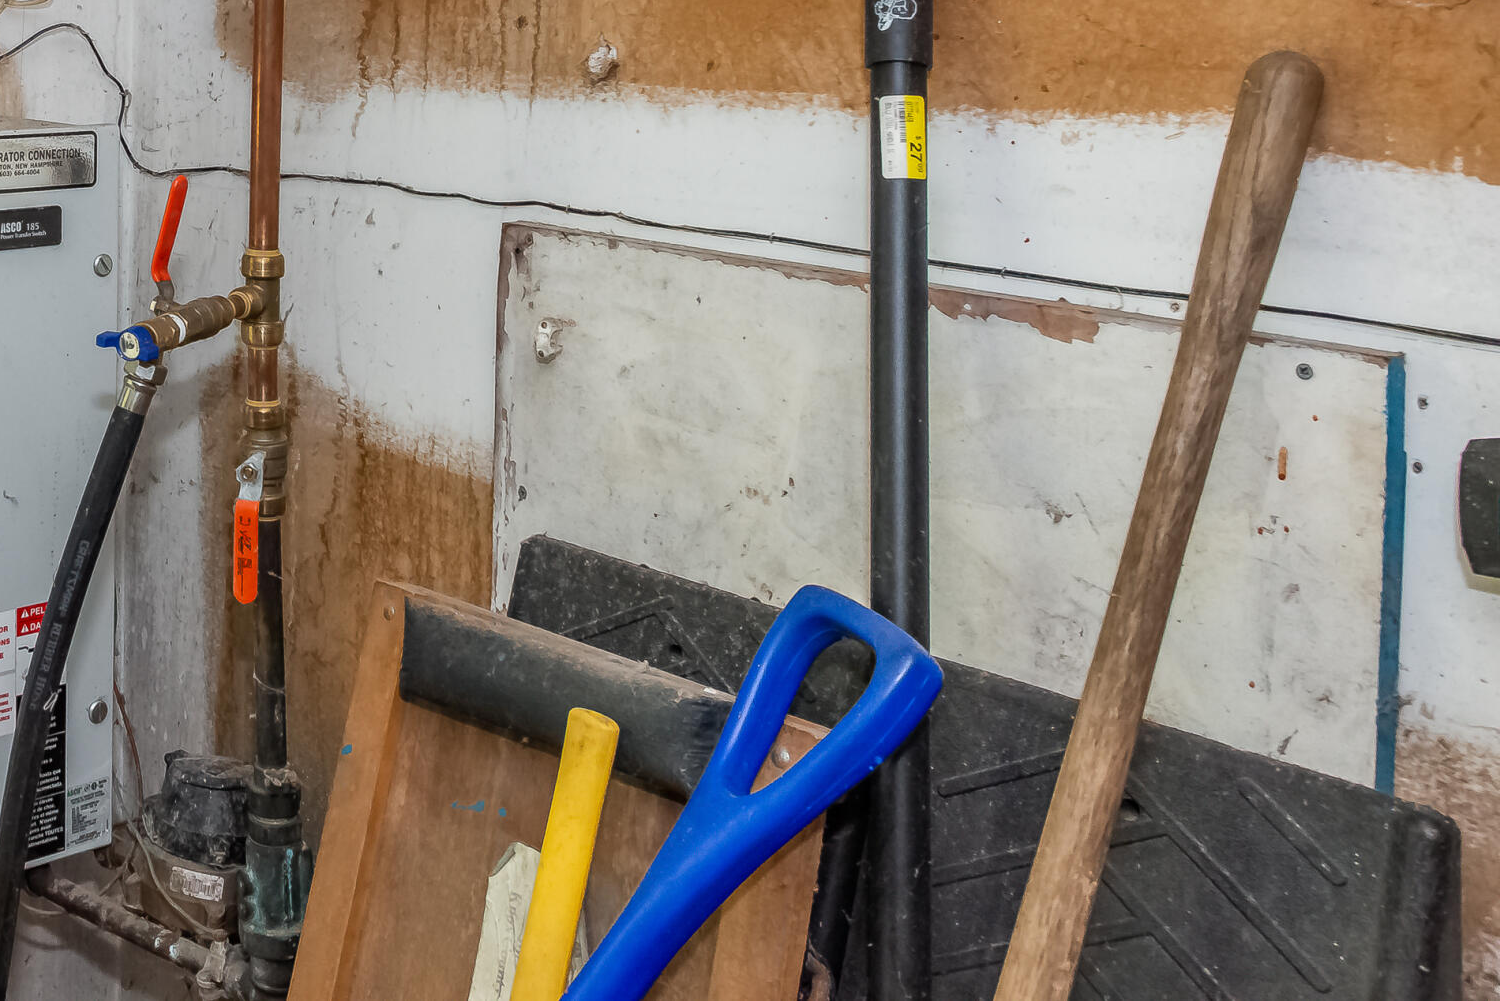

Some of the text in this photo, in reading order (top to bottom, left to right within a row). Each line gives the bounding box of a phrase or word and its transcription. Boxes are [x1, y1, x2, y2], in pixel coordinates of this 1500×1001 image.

[28, 148, 82, 161] CONNECTION
[910, 142, 923, 162] 27
[30, 160, 63, 168] HAMPSHIRE
[0, 221, 40, 234] ASCO 185
